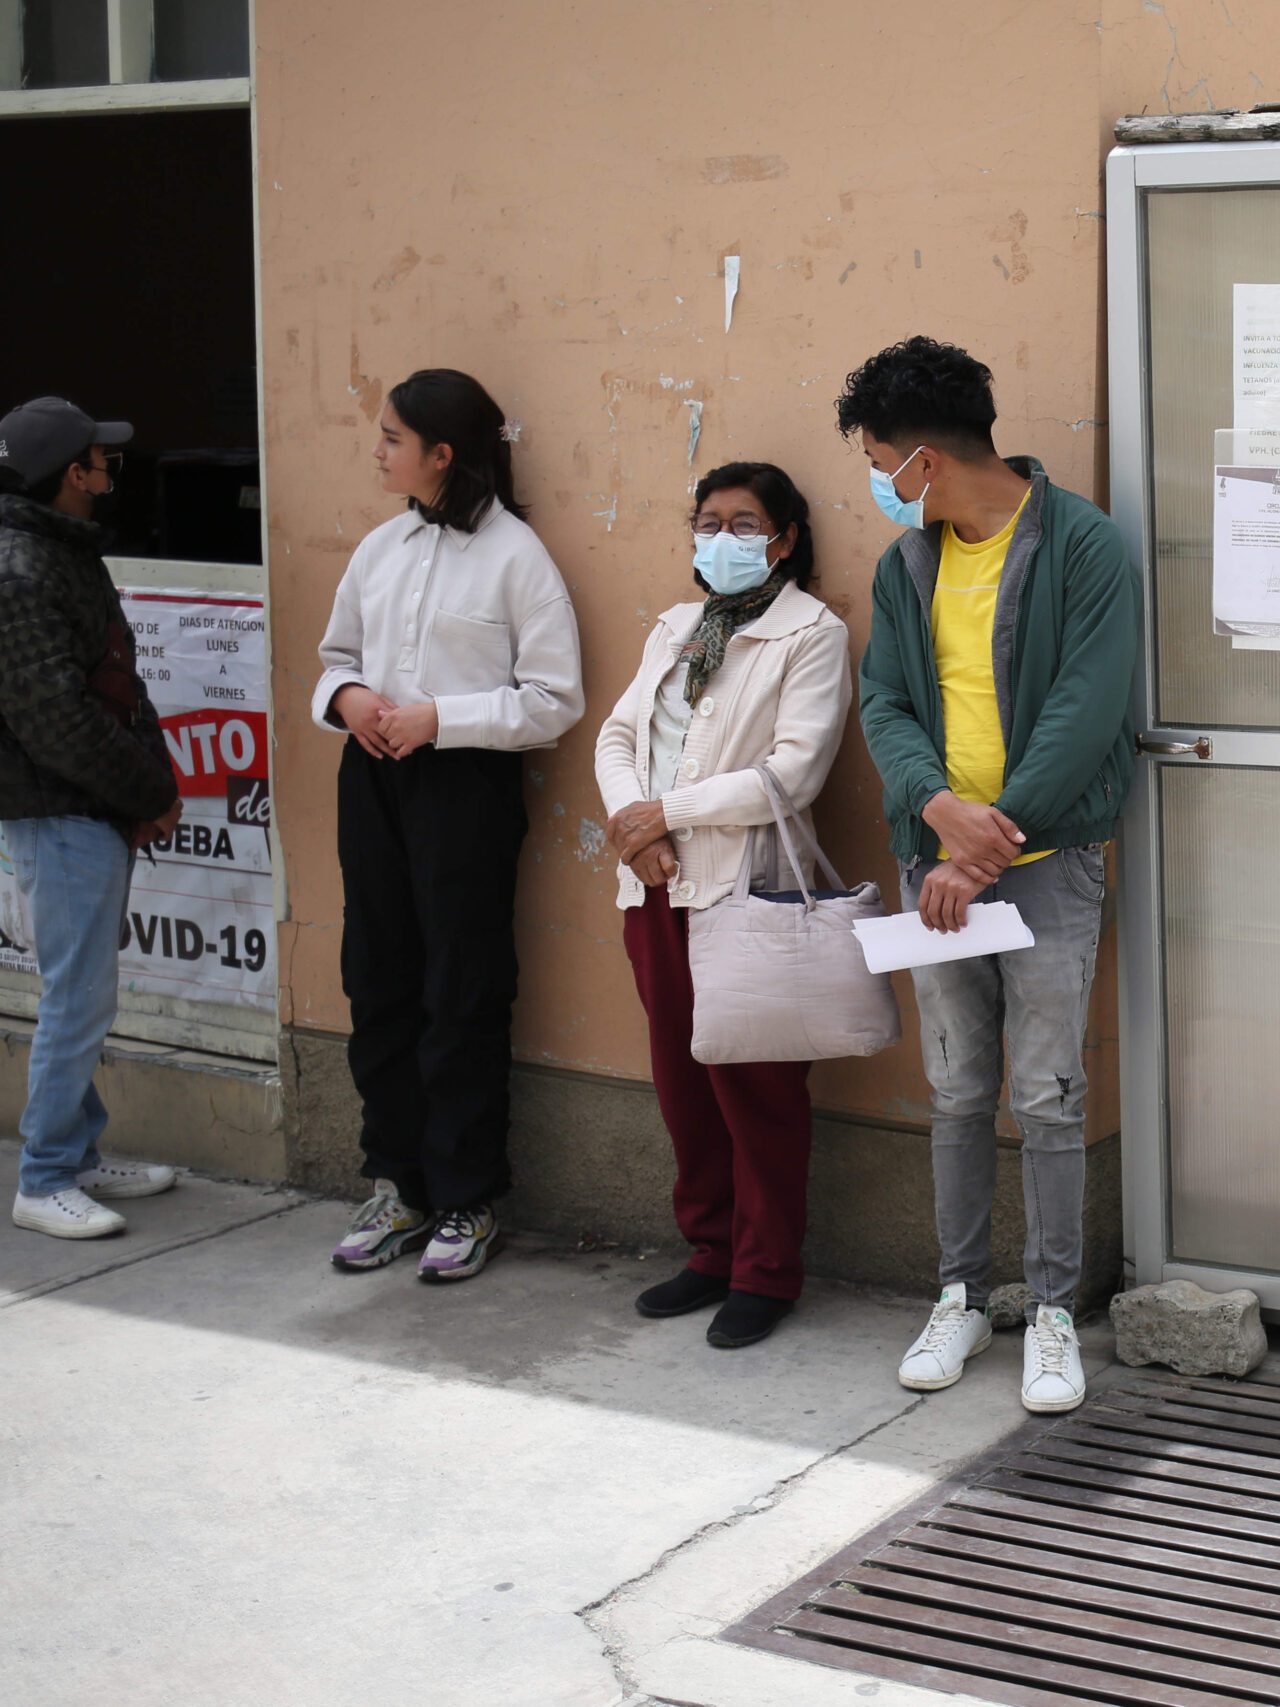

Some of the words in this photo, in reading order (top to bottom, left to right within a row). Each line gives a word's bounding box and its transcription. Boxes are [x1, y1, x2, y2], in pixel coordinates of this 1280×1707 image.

[146, 623, 160, 635] DE
[179, 616, 201, 628] DIAS
[204, 618, 215, 629] DE
[217, 619, 265, 633] ATENCION
[152, 646, 165, 659] DE
[206, 639, 239, 653] LUNES
[219, 664, 227, 676] A
[203, 685, 246, 700] VIERNES
[235, 781, 271, 820] de
